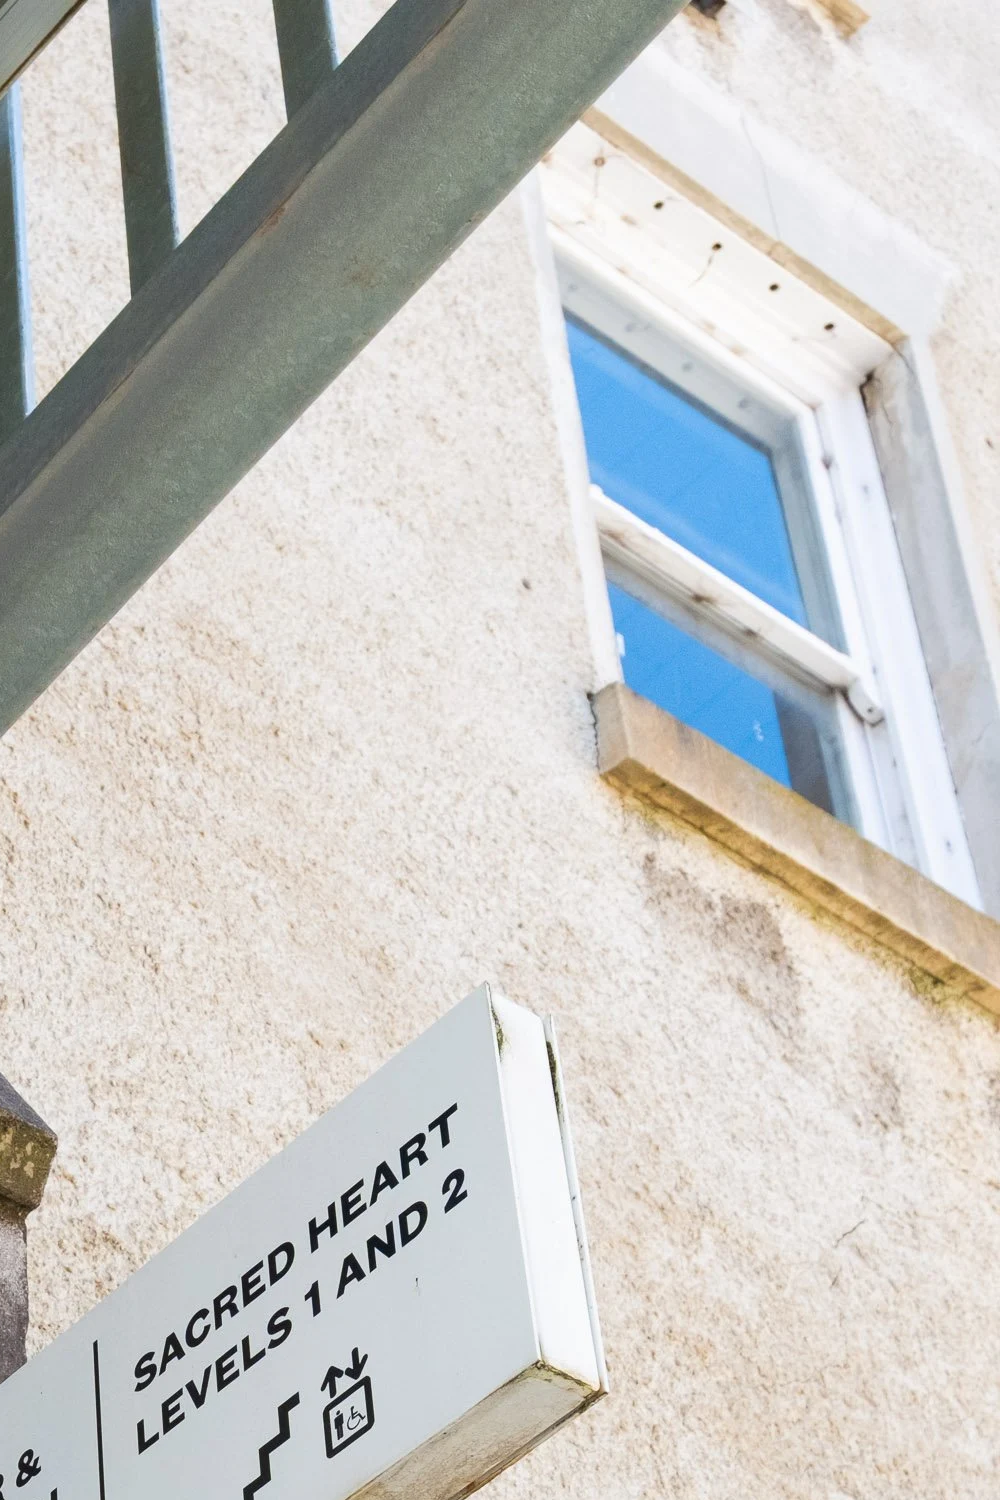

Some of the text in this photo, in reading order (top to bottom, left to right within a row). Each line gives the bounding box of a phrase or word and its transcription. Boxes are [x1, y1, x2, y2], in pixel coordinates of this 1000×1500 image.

[134, 1102, 458, 1392] SACRED HEART
[136, 1168, 468, 1455] LEVELS 1 AND 2
[15, 1448, 42, 1488] &
